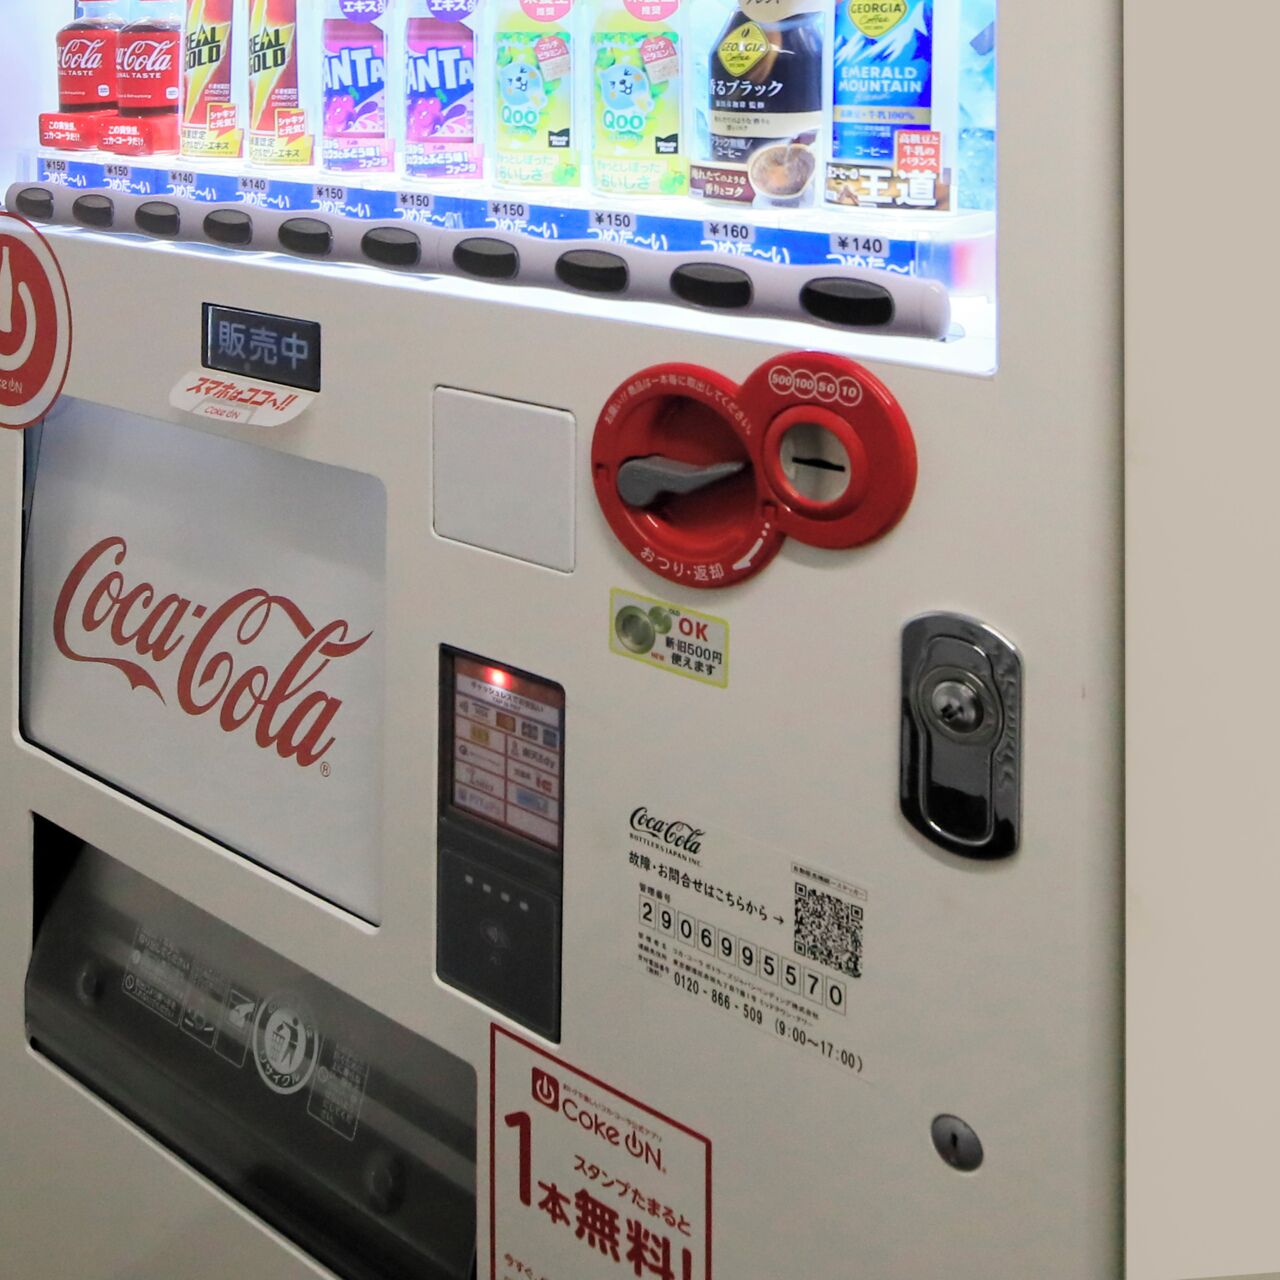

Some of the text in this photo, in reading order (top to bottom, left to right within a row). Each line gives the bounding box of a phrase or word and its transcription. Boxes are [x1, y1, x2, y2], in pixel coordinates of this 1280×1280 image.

[850, 2, 903, 15] GEORGIA
[405, 47, 475, 95] ANTA
[841, 66, 918, 80] EMERALD
[838, 79, 922, 93] MOUNTAIN
[501, 105, 538, 125] Qoo
[603, 110, 644, 130] Qoo
[855, 145, 889, 157] コーヒー
[46, 160, 66, 171] ¥150
[107, 165, 129, 177] ¥150
[171, 172, 194, 184] ¥140
[241, 178, 266, 190] ¥140
[316, 186, 343, 199] ¥150
[400, 193, 430, 207] ¥150
[492, 202, 525, 216] ¥150
[595, 212, 631, 227] ¥150
[710, 223, 749, 239] ¥160
[837, 237, 883, 253] ¥140
[218, 319, 309, 370] 販売中
[771, 374, 856, 398] 500 100 50 10
[639, 546, 725, 581] おつり・返却
[678, 617, 709, 642] OK
[53, 536, 374, 767] Coca-Cola
[671, 652, 716, 677] 使えます
[629, 806, 707, 854] Coca-Cola
[628, 850, 768, 921] 故障・お問合せはこちらから
[562, 1097, 620, 1146] Coke
[574, 1153, 692, 1237] スタンプたまると
